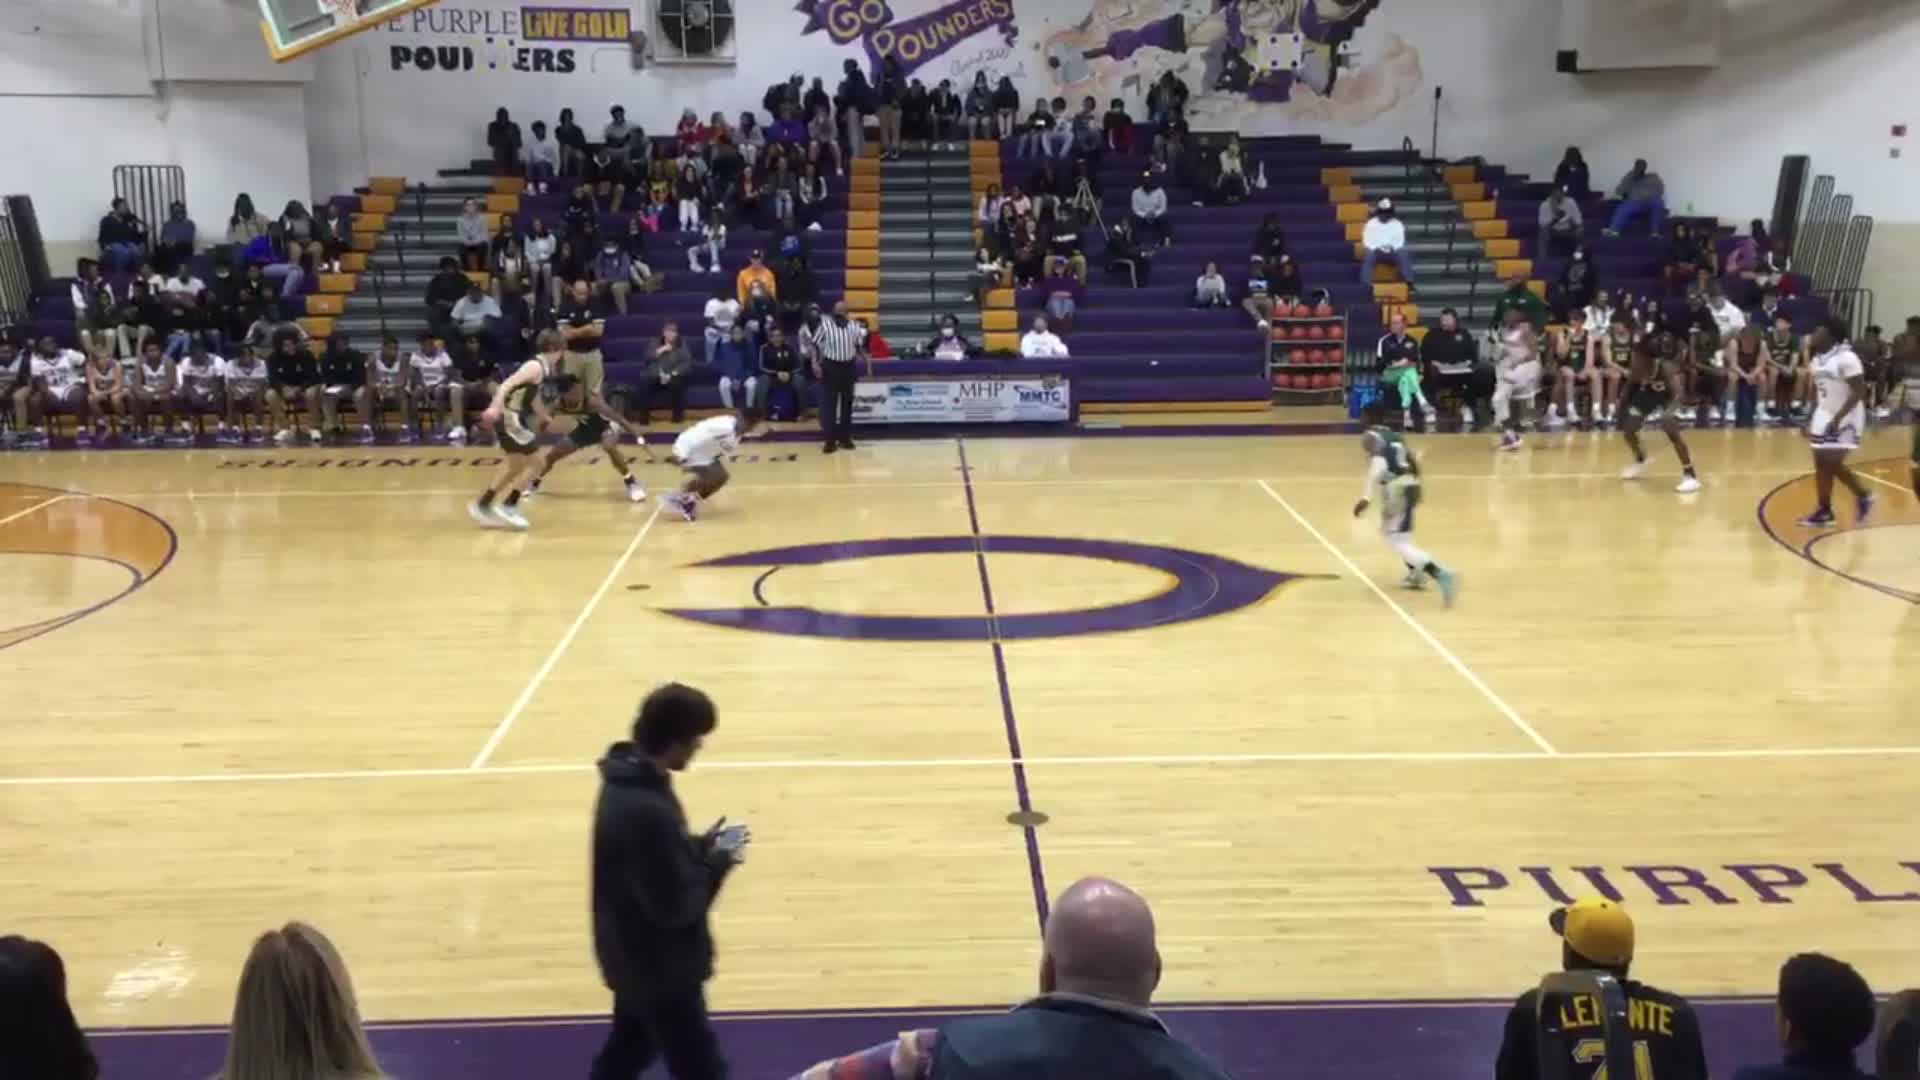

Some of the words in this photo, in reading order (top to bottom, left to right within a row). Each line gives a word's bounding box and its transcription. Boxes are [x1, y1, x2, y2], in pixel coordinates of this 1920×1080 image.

[413, 7, 517, 34] PURPLE
[574, 11, 629, 39] GOLD
[872, 0, 1010, 60] POUNDERS
[390, 46, 576, 73] POUERS
[960, 383, 1005, 399] MHP
[1019, 391, 1061, 402] MMTC
[1428, 863, 1920, 907] PURPL
